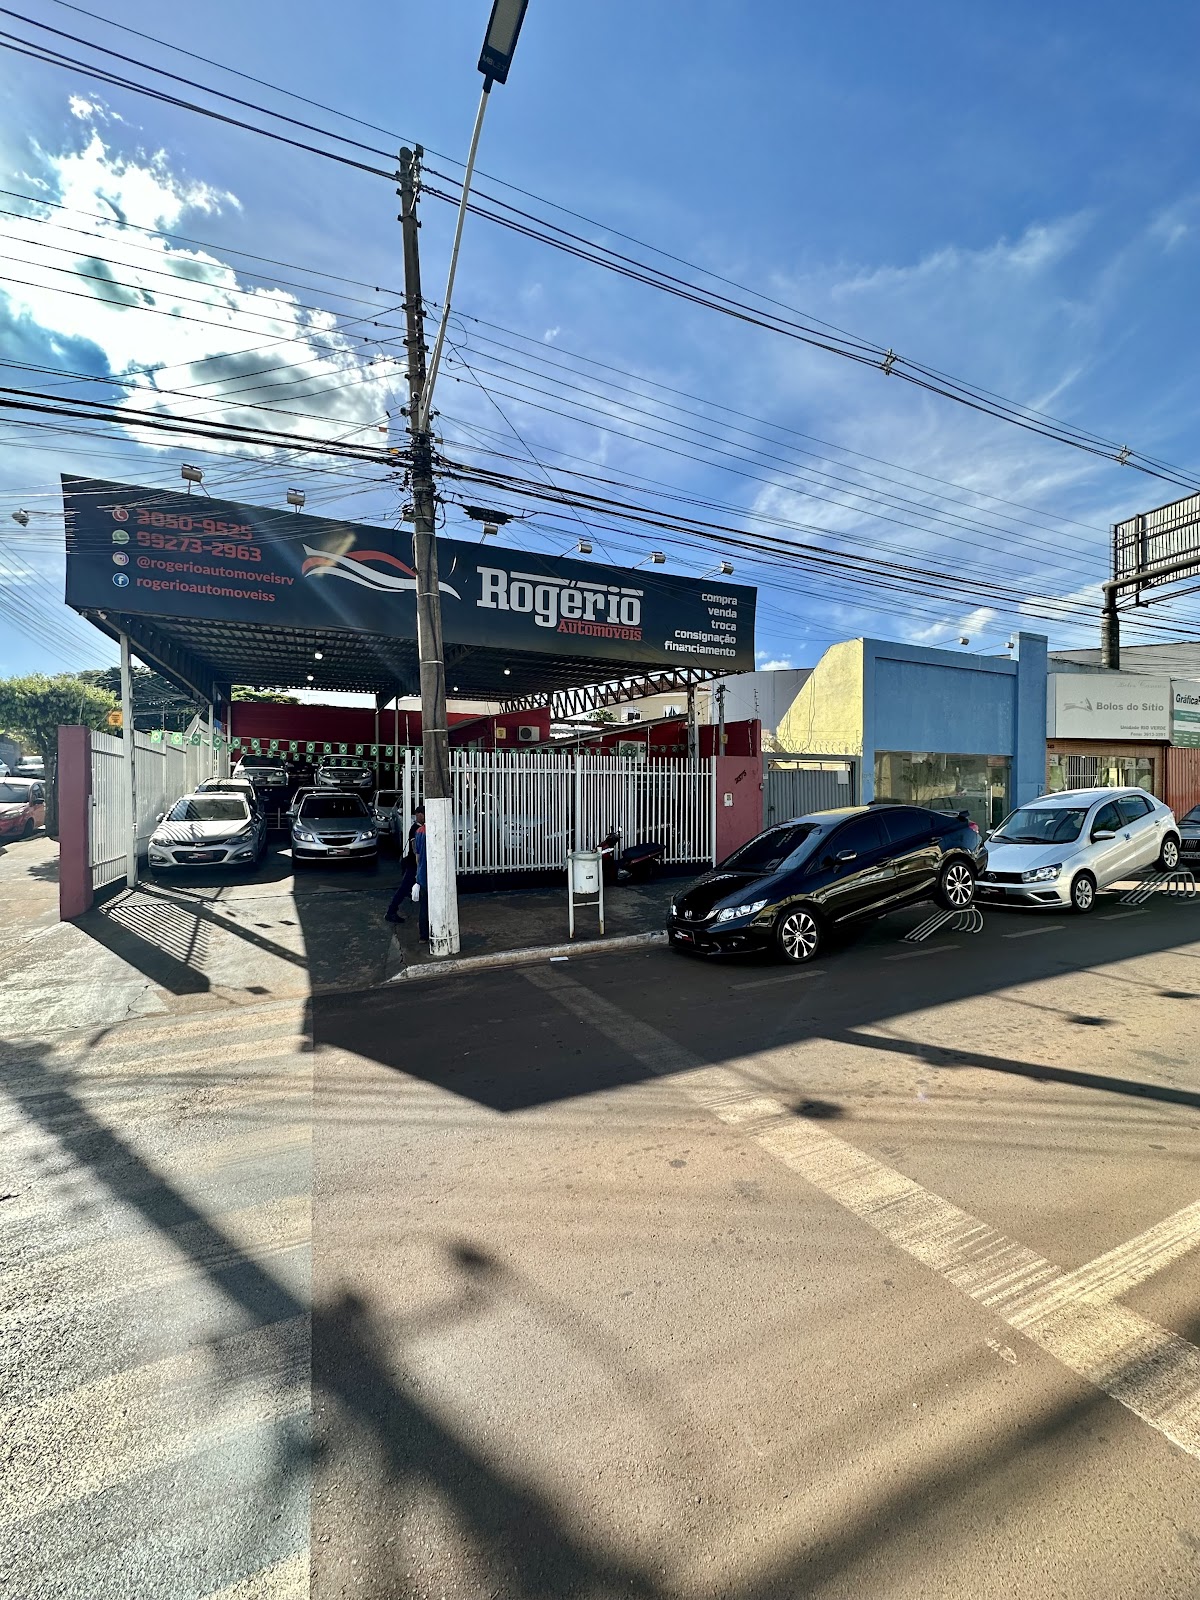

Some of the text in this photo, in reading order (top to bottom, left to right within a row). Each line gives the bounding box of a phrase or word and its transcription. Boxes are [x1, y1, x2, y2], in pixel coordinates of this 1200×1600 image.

[136, 531, 262, 562] 99273-2963
[136, 555, 295, 586] @rogerioautomoveisrv
[136, 576, 276, 602] rogerioautomoveiss
[476, 565, 645, 628] Rogério
[701, 593, 738, 605] compra
[707, 607, 738, 618] venda
[711, 619, 737, 631] troca
[674, 629, 737, 645] consignação
[664, 640, 736, 657] financiamento
[1096, 701, 1124, 711] Bolos
[1126, 702, 1139, 711] do
